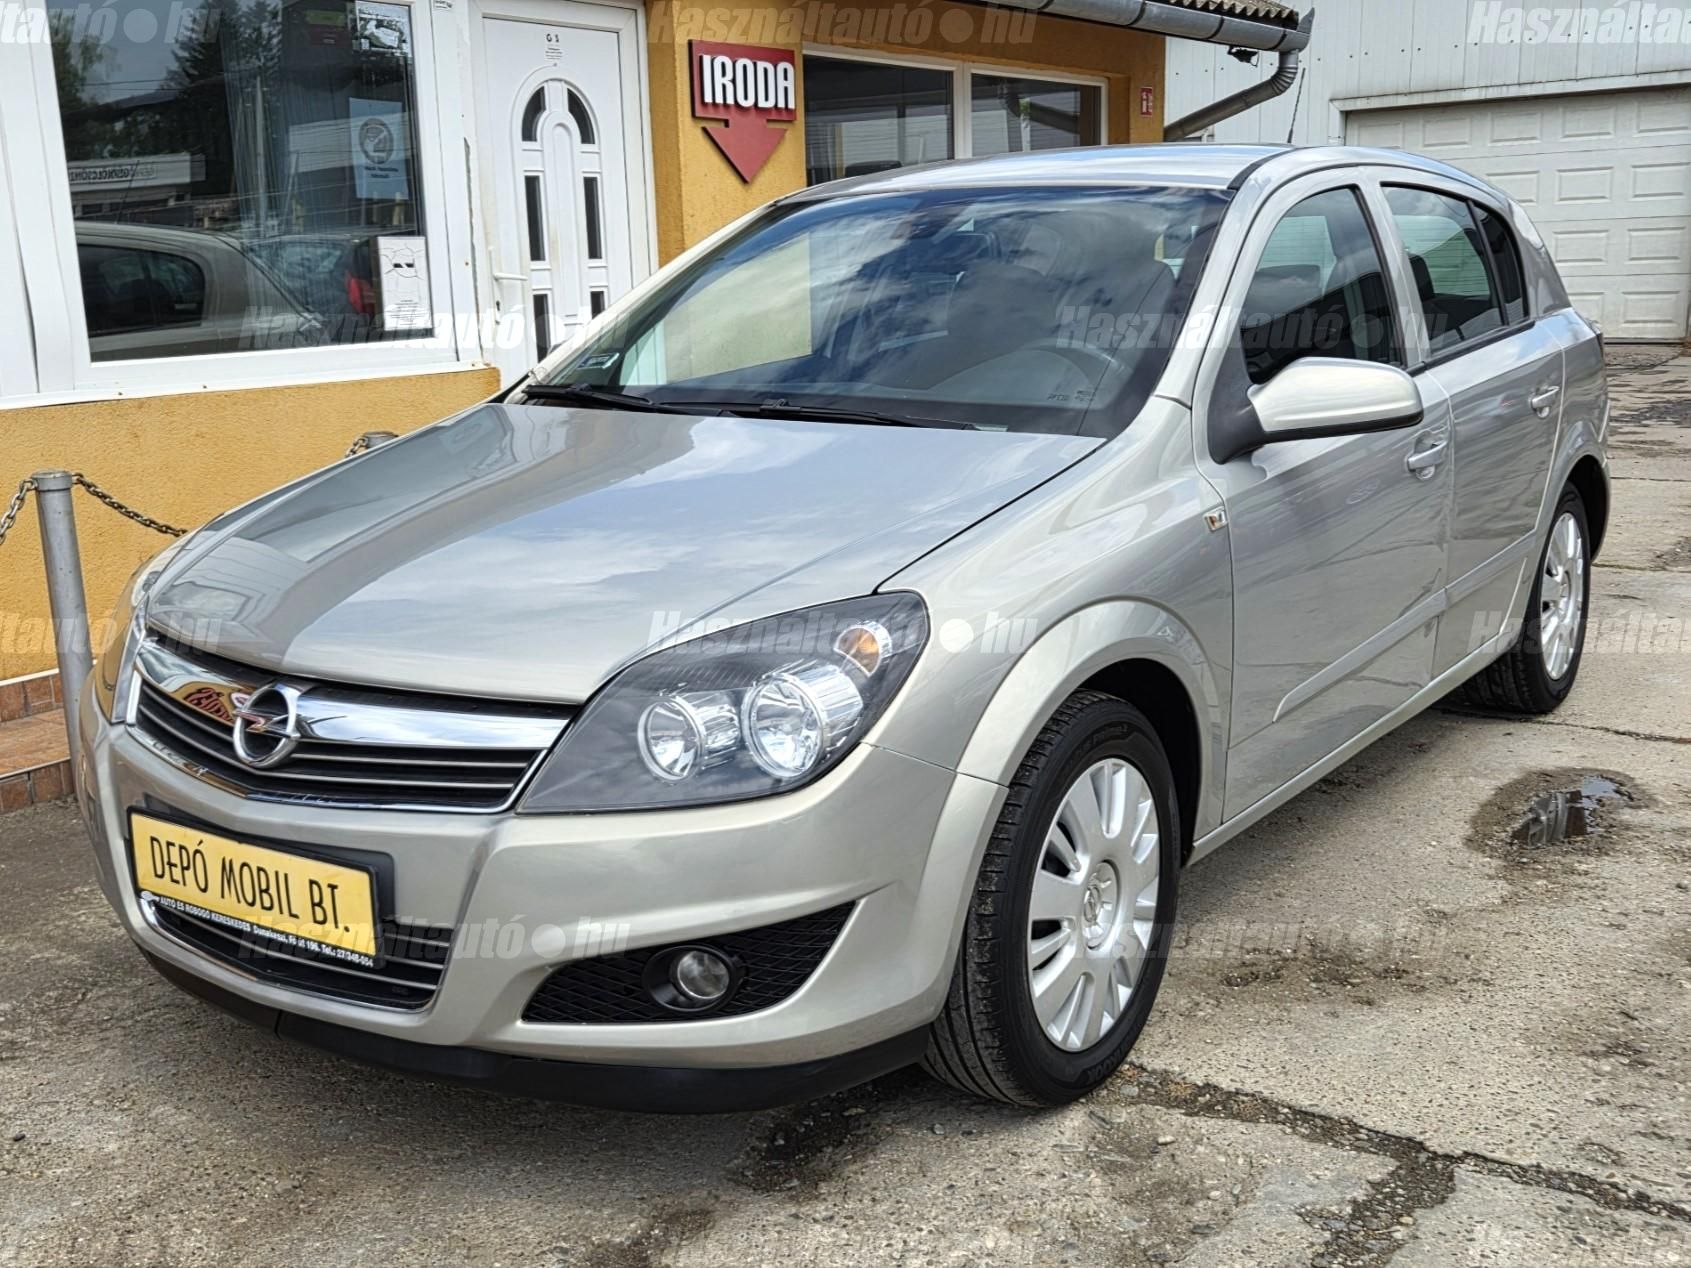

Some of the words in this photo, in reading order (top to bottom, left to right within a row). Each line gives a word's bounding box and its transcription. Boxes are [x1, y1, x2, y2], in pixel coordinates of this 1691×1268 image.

[700, 54, 796, 110] IRODA
[149, 835, 209, 894] DEPÓ
[220, 855, 300, 920] MOBIL
[308, 878, 351, 933] BT.
